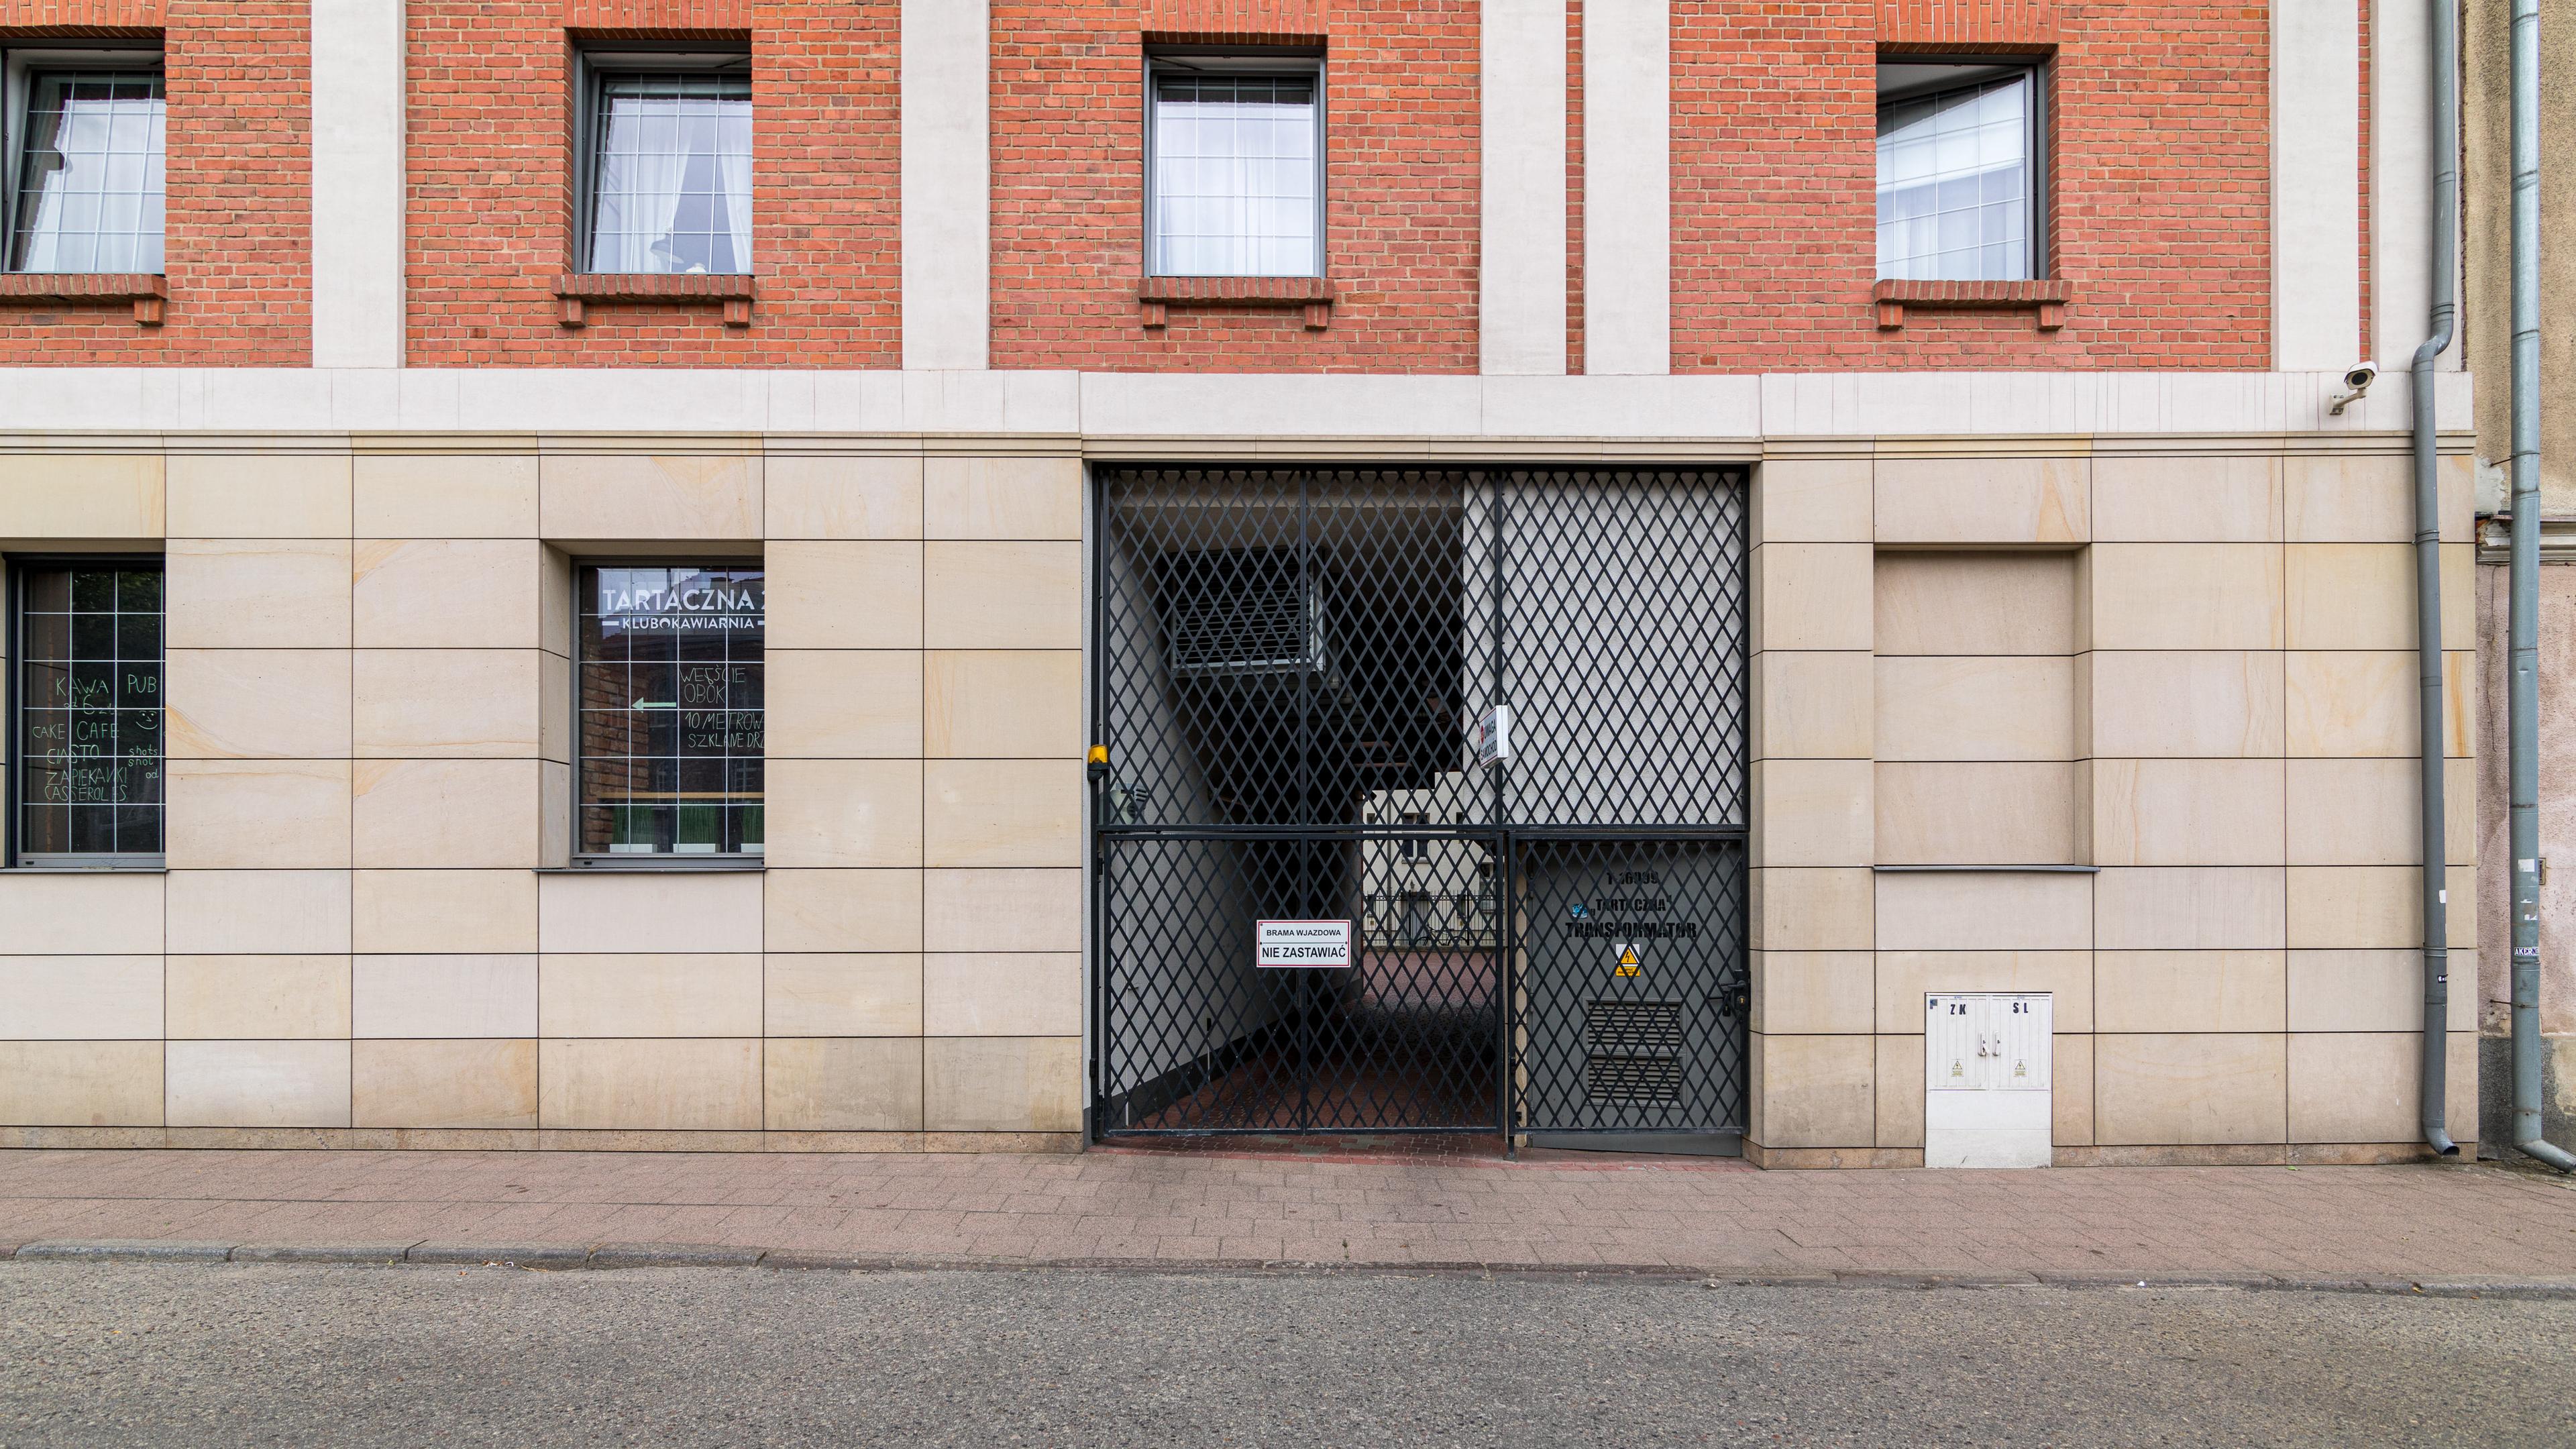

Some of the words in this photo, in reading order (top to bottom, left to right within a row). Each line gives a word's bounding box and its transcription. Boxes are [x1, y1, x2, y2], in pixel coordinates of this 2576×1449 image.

[602, 589, 755, 610] TARTACZNA
[623, 617, 755, 629] KLUBOKAWIARNIA
[56, 677, 109, 696] KAWA
[127, 674, 156, 694] PUB
[684, 684, 726, 704] OBOK
[83, 694, 95, 715] 6
[685, 712, 700, 729] 10
[33, 724, 65, 739] CAKE
[77, 720, 119, 741] CAFE
[688, 733, 744, 748] SZKLANE
[47, 744, 99, 765] CIASTO
[129, 744, 158, 757] shots
[146, 769, 159, 779] od
[1262, 947, 1279, 957] NIE
[1283, 945, 1346, 957] ZASTAWIAĆ
